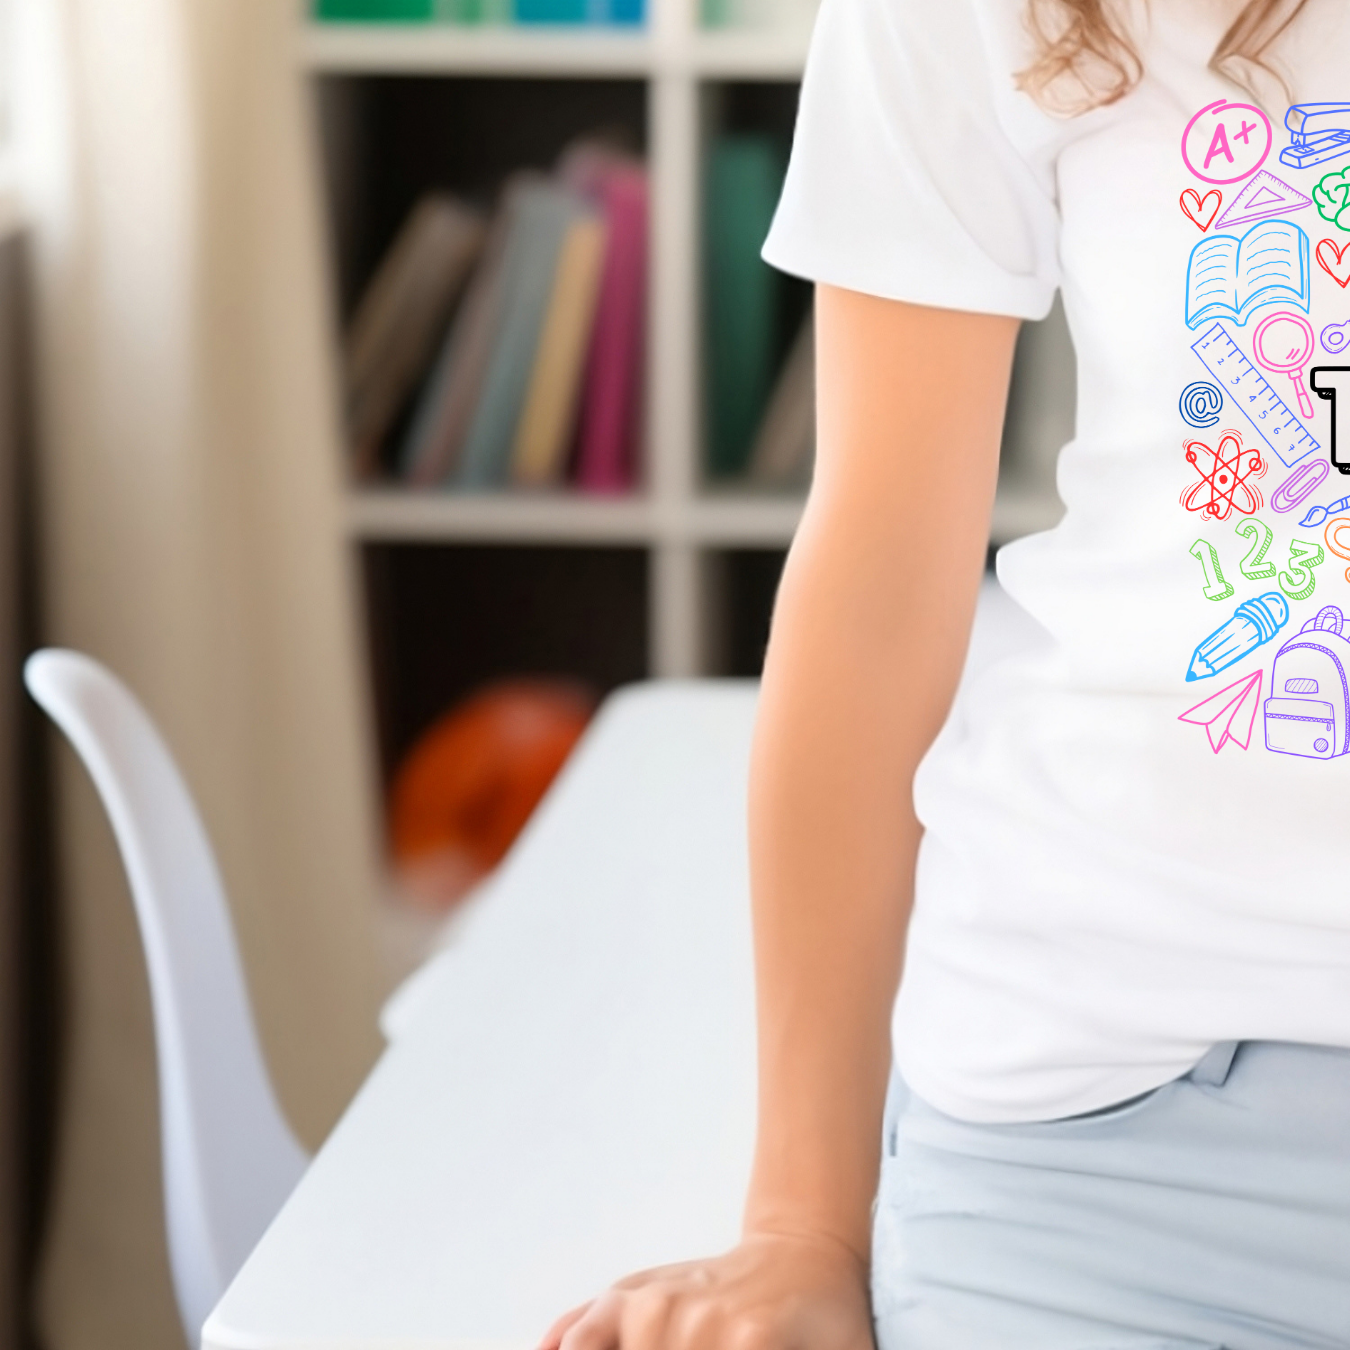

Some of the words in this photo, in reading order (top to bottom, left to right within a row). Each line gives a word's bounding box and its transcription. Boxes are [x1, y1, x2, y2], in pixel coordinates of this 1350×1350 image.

[1203, 120, 1258, 170] A+
[1178, 380, 1224, 429] @
[1201, 341, 1211, 350] 1
[1216, 357, 1225, 366] 2
[1230, 376, 1241, 385] 3
[1248, 395, 1258, 403] 4
[1258, 410, 1269, 420] 5
[1273, 427, 1282, 435] 6
[1287, 443, 1296, 452] 7
